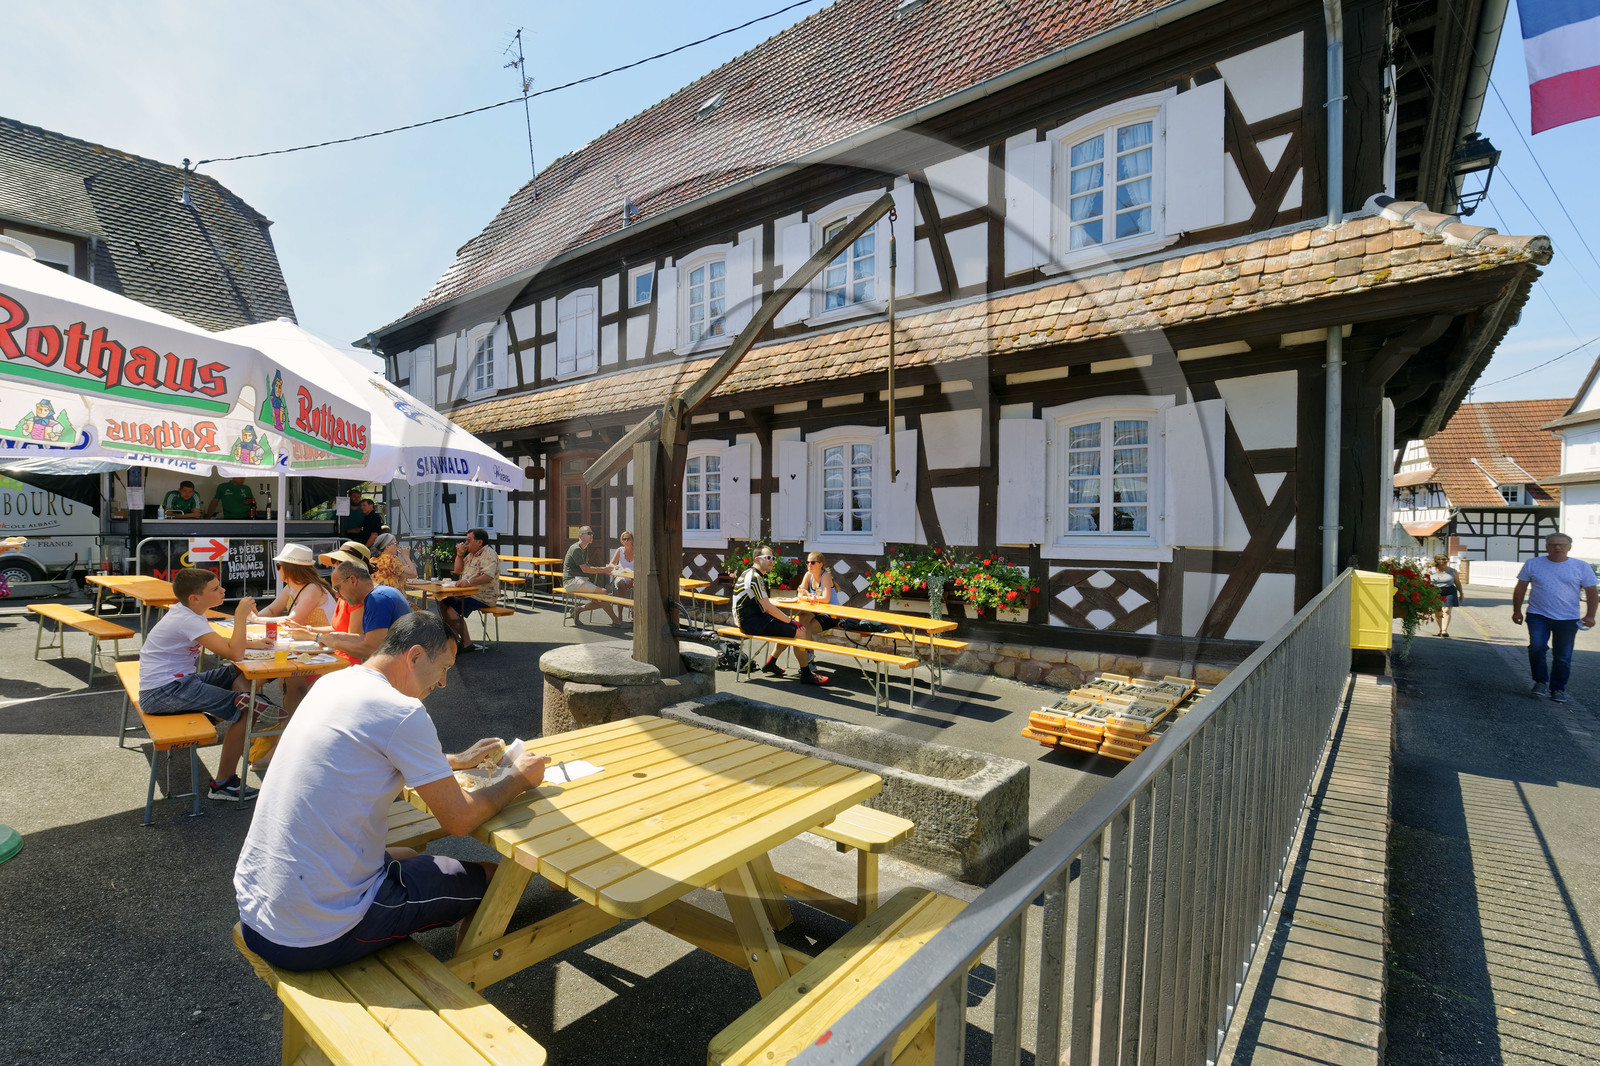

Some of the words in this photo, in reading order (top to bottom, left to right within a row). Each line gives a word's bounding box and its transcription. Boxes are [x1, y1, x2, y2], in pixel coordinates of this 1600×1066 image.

[295, 385, 367, 451] Rothaus
[3, 491, 73, 516] BOURG
[229, 547, 238, 555] ES
[234, 555, 243, 563] ET
[228, 560, 264, 572] HOMMES
[228, 571, 250, 580] DEPUS
[251, 570, 265, 578] 1640
